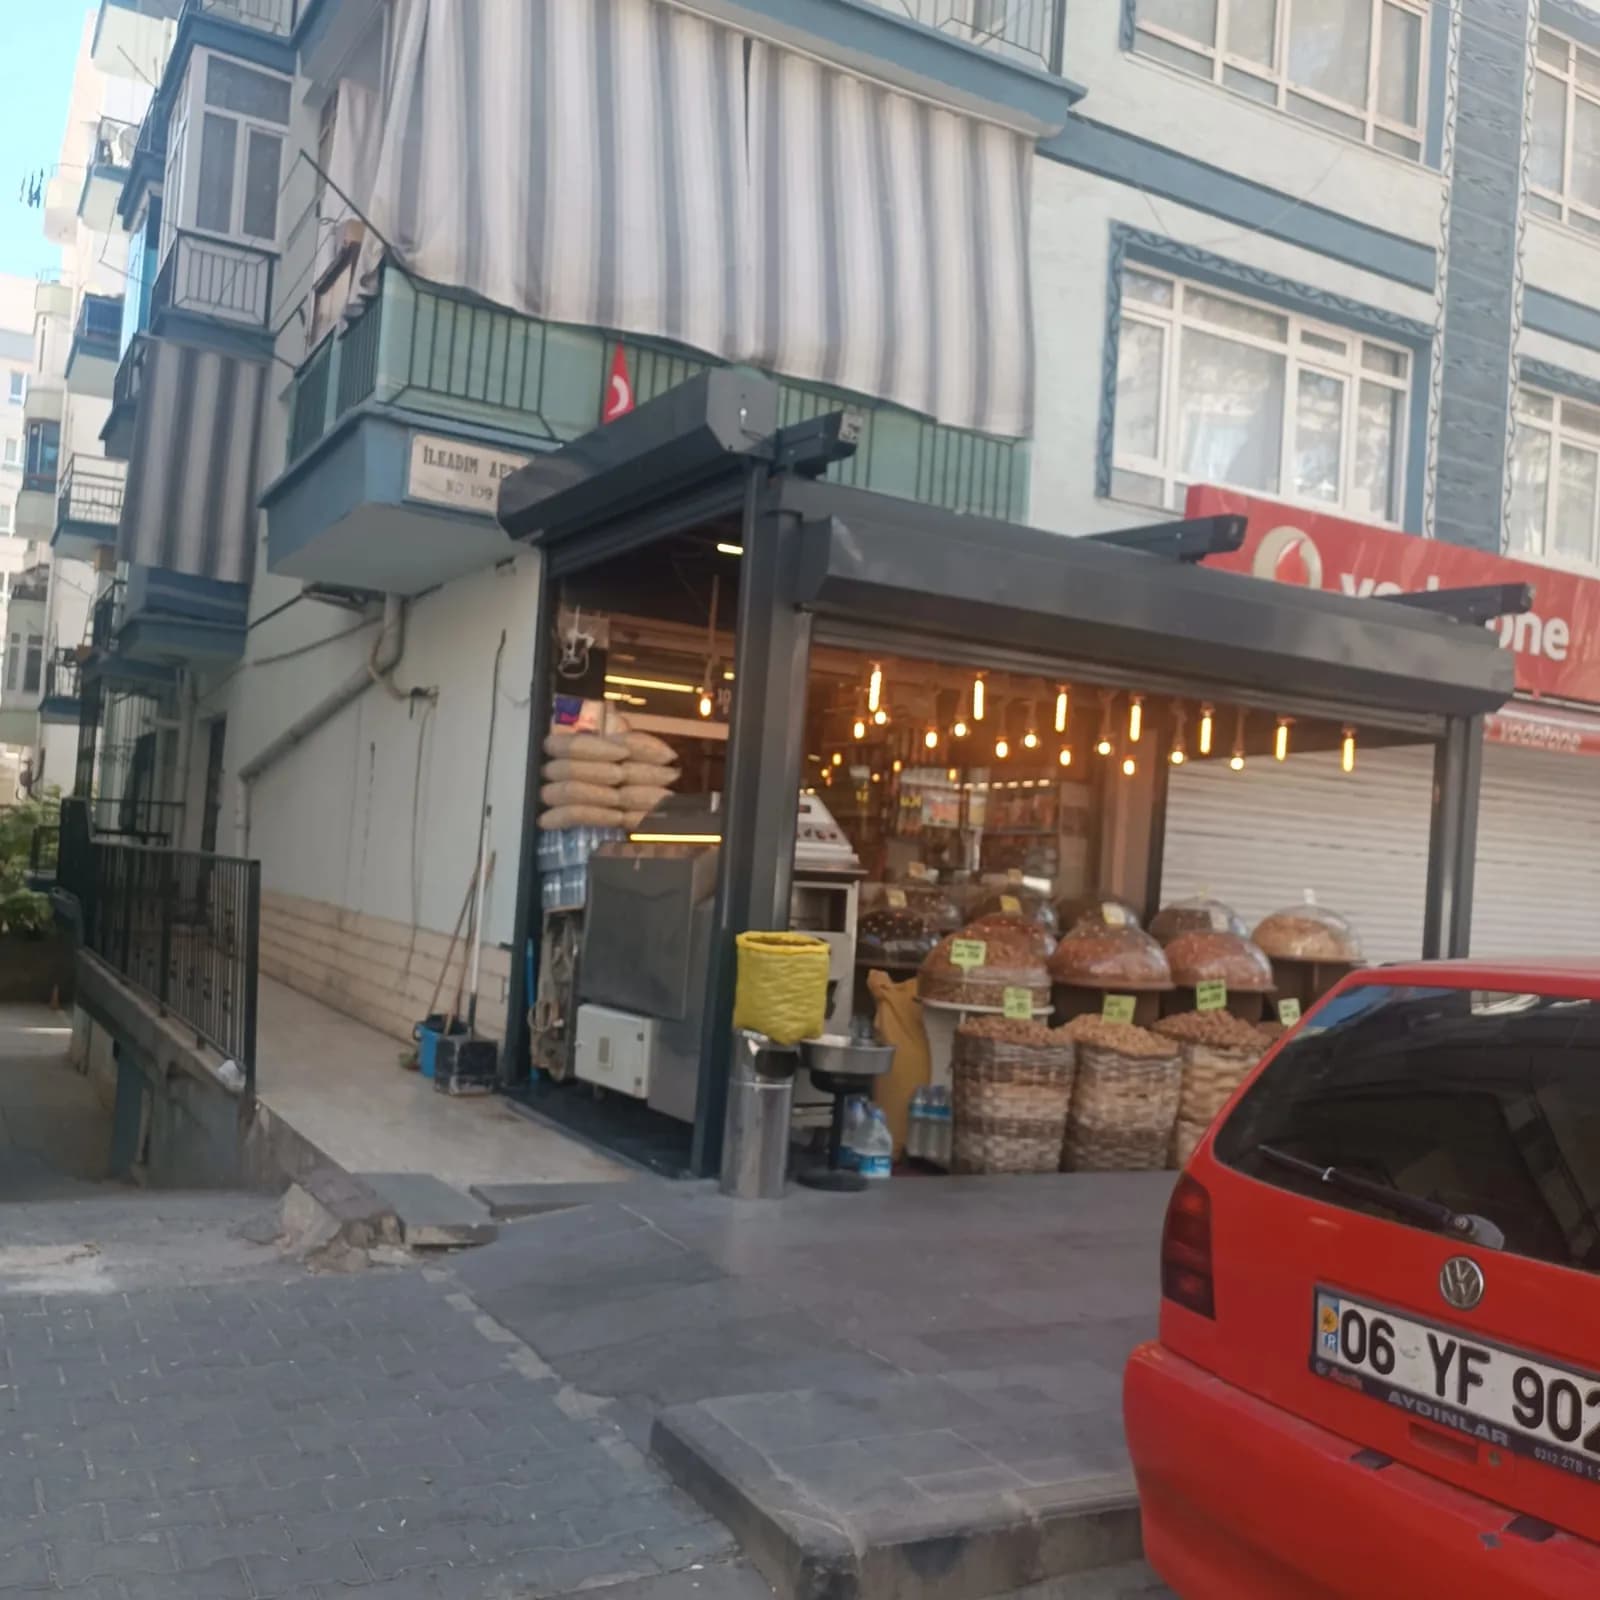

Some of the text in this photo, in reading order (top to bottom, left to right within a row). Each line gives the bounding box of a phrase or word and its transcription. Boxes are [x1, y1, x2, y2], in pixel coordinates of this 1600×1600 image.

[1340, 1308, 1396, 1376] 06
[1427, 1332, 1492, 1406] YF
[1388, 1391, 1509, 1447] AYDINLAR
